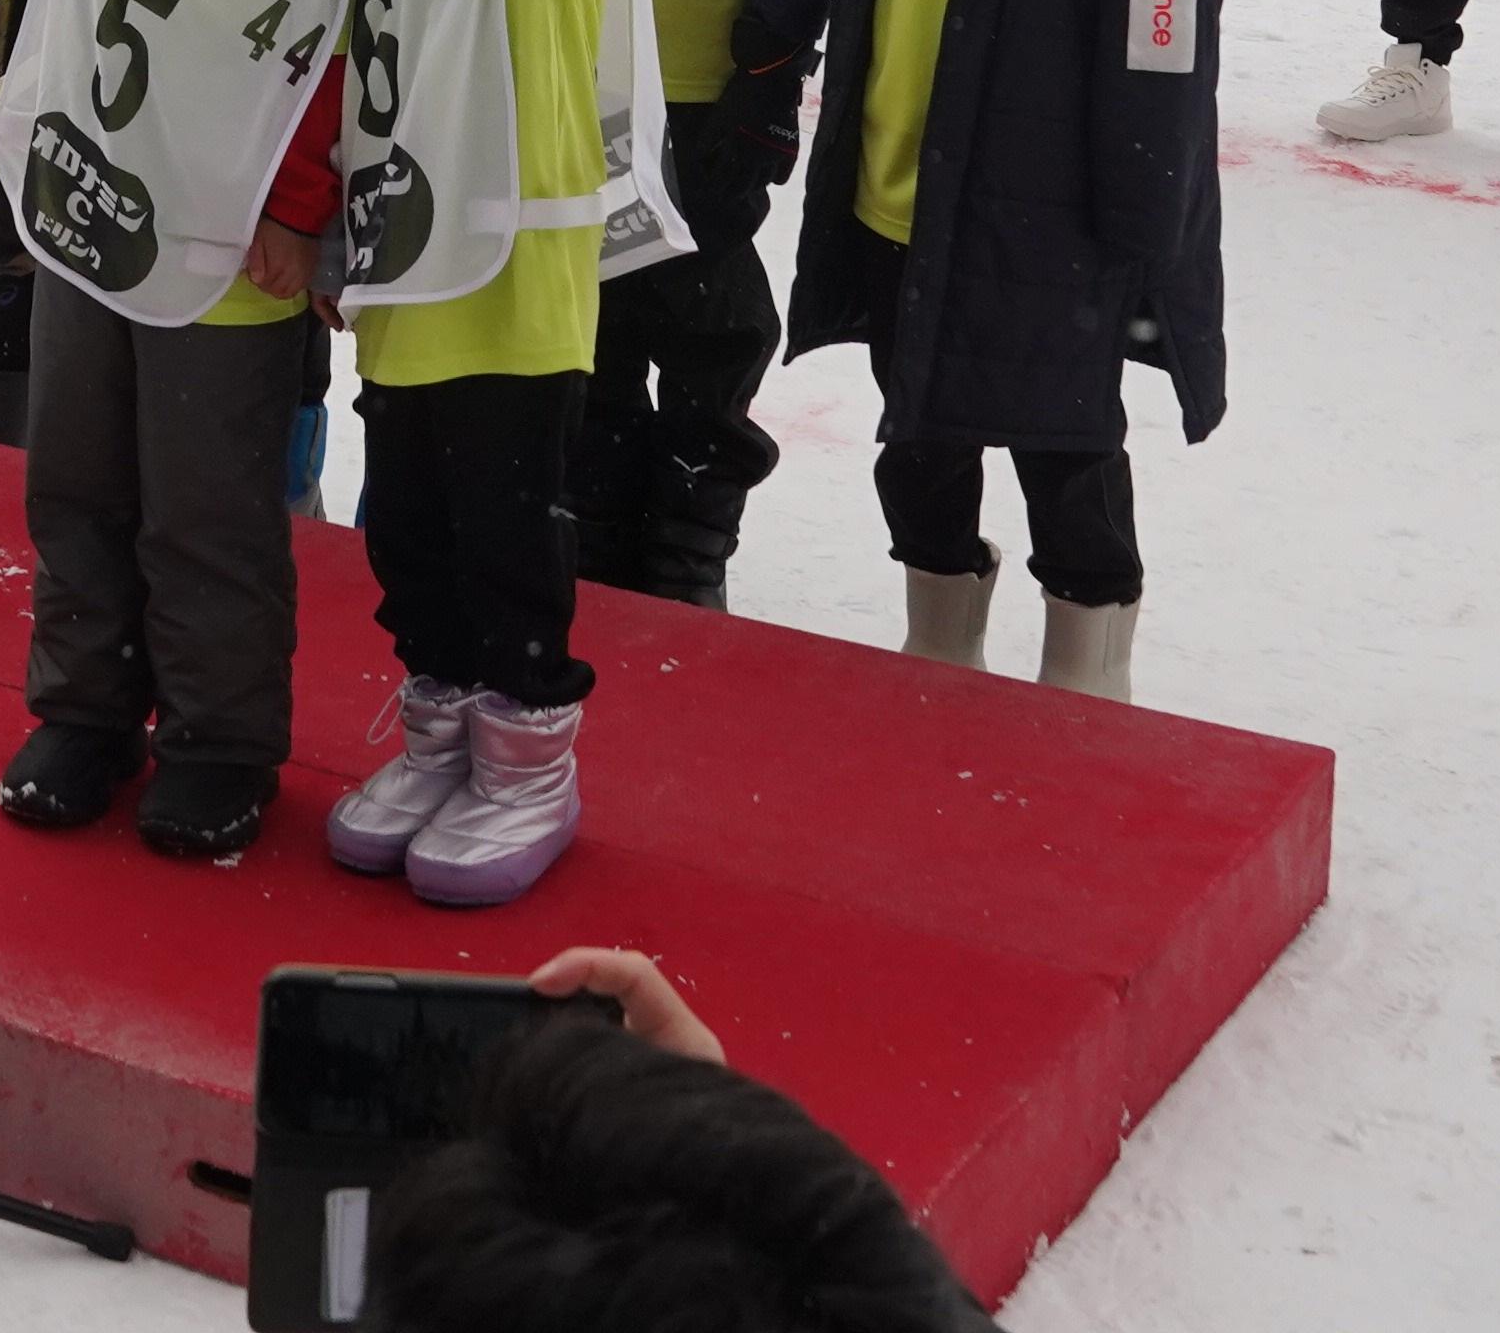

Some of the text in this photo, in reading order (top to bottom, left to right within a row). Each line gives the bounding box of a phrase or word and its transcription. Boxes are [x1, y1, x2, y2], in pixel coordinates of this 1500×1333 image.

[31, 123, 149, 233] オロナミン
[66, 190, 94, 226] C
[34, 209, 103, 271] ドリンク
